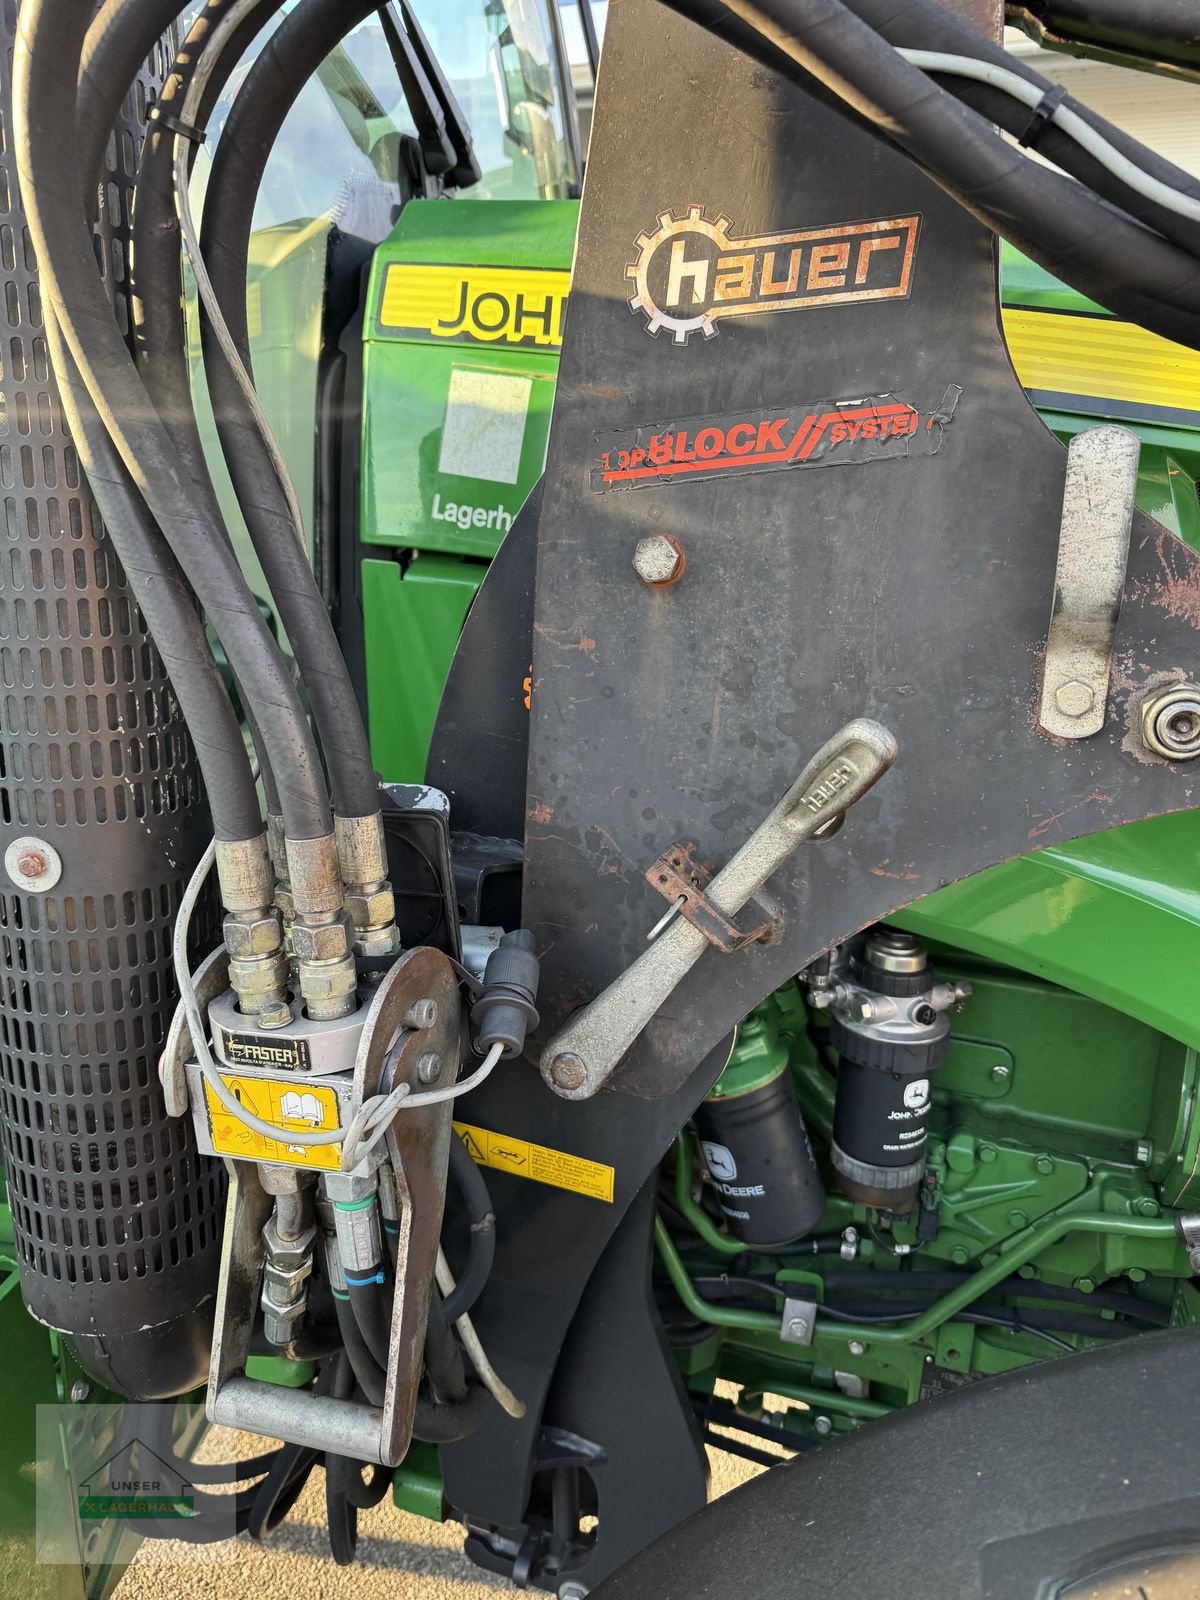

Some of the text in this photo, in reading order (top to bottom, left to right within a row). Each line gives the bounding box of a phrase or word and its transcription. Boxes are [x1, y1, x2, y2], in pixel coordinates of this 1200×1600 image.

[665, 236, 901, 307] hauer
[648, 417, 789, 465] BLOCK
[431, 493, 517, 532] Lagerh
[245, 1044, 293, 1063] FASTER
[887, 1111, 912, 1120] JOHN
[722, 1183, 766, 1197] DEERE
